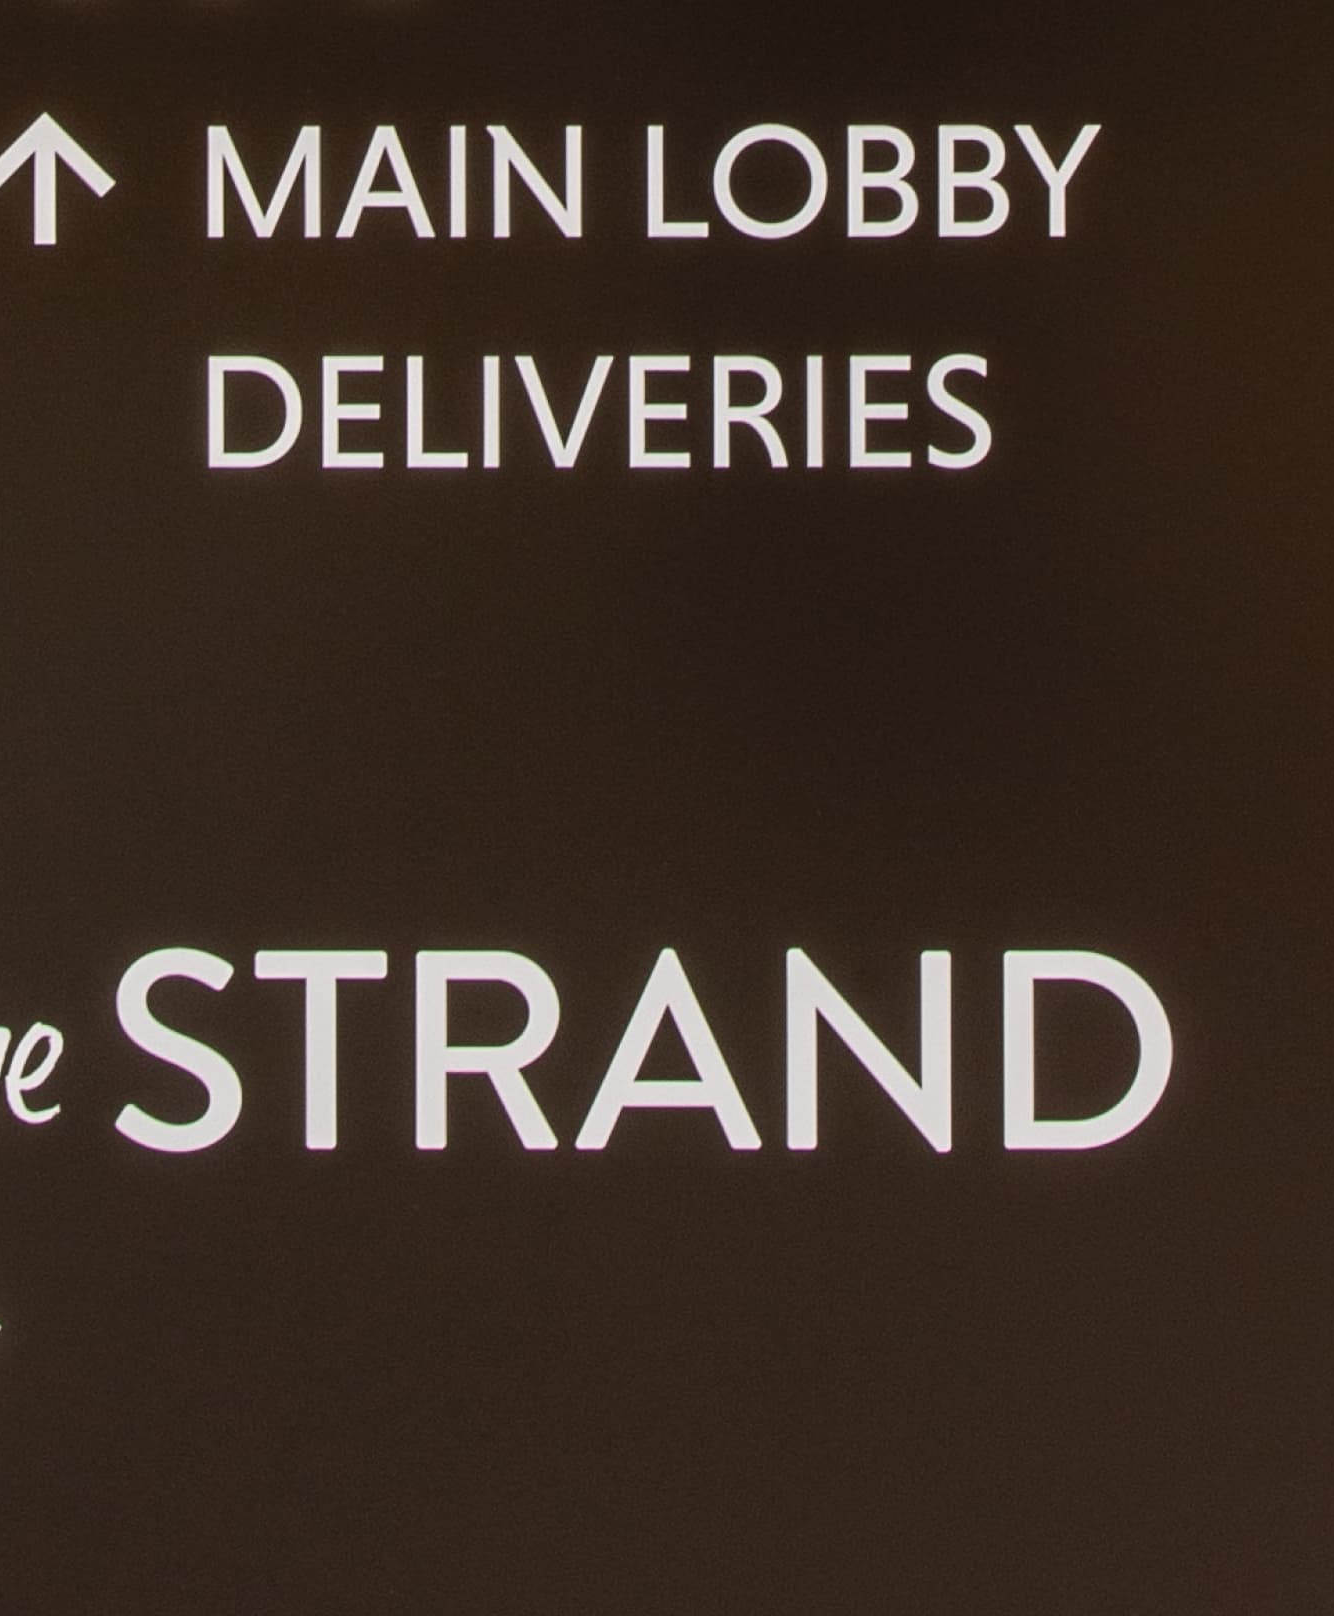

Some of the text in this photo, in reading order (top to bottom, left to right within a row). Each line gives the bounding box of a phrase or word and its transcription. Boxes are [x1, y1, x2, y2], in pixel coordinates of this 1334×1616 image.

[206, 123, 1102, 240] MAIN LOBBY
[207, 352, 993, 470] DELIVERIES
[114, 946, 1174, 1154] STRAND
